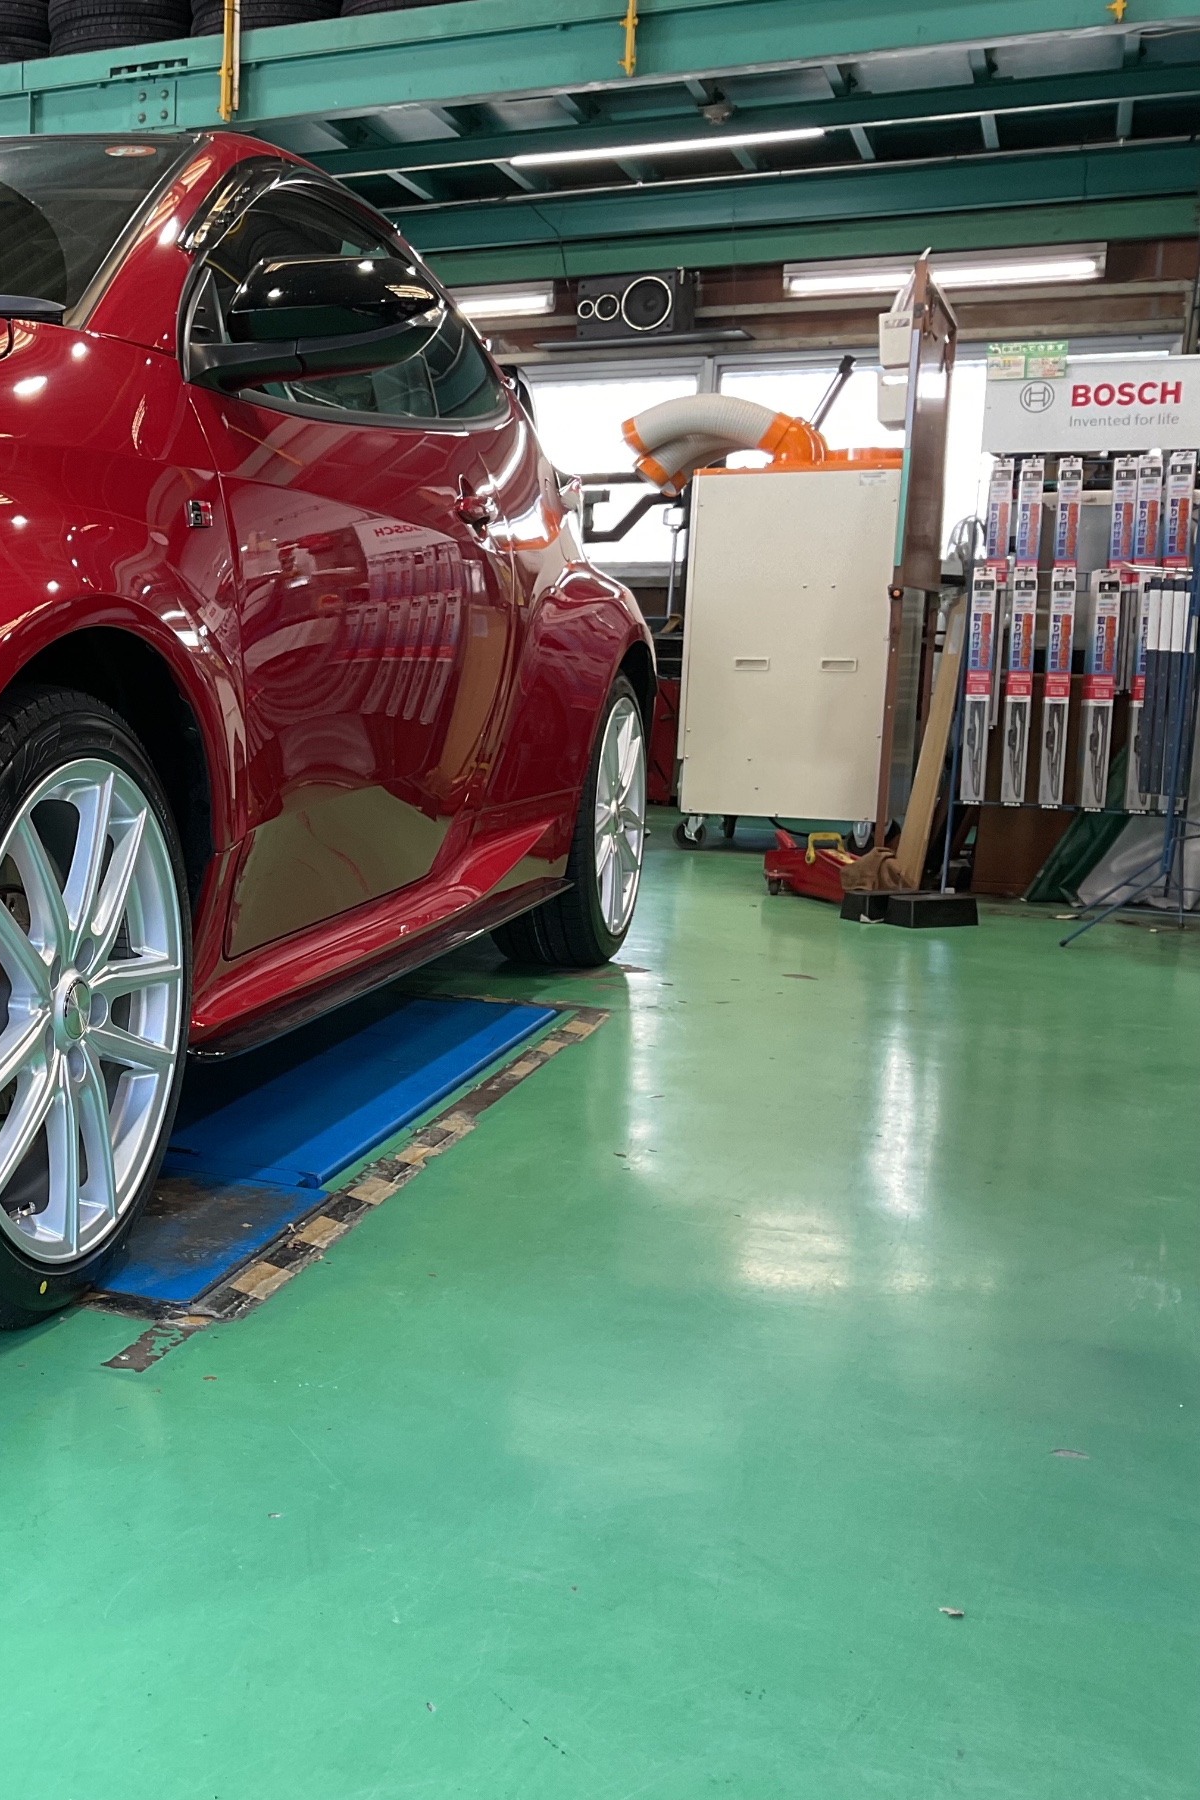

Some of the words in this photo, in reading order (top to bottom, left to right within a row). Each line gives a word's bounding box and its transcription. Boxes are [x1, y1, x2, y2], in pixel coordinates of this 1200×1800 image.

[1071, 381, 1182, 407] BOSCH
[1069, 414, 1131, 427] Invented
[1135, 413, 1155, 426] for
[1157, 412, 1180, 425] life
